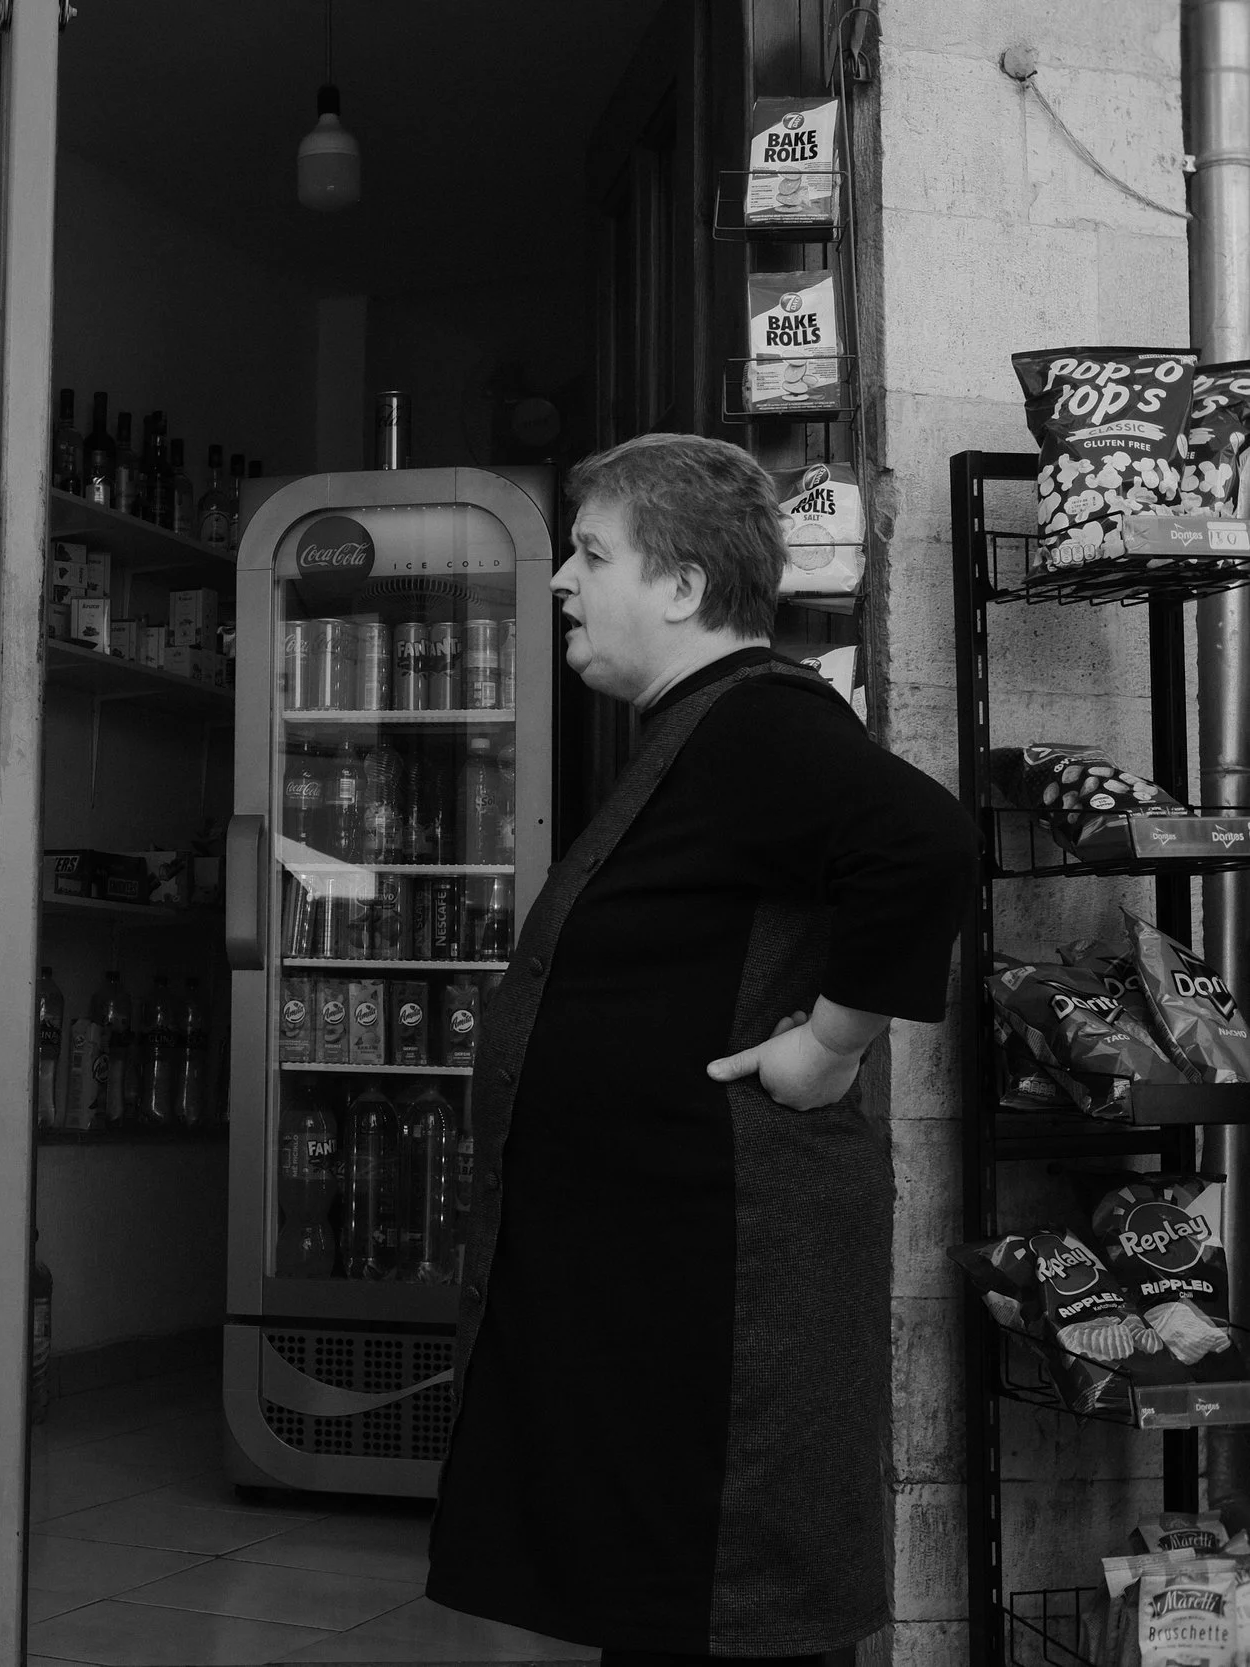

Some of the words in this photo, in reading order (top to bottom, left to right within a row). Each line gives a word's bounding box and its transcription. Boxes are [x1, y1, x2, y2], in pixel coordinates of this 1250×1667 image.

[767, 130, 817, 147] BAKE
[764, 144, 818, 163] ROLLS
[767, 313, 817, 332] BAKE
[766, 327, 821, 347] ROLLS
[1088, 423, 1146, 436] CLASSIC
[1083, 439, 1125, 449] GLUTEN
[1128, 440, 1151, 452] FREE
[392, 561, 428, 571] ICE
[446, 559, 501, 569] COLD
[1211, 831, 1245, 842] Doritos
[1103, 1032, 1131, 1044] TACO
[1218, 1027, 1248, 1039] NACHO
[1118, 1213, 1212, 1258] Replay
[1035, 1248, 1094, 1284] Replay
[1140, 1278, 1214, 1297] RIPPLED
[1057, 1292, 1125, 1319] RIPPLED
[1160, 1590, 1220, 1616] Maretti
[1148, 1626, 1229, 1642] Bruschette
